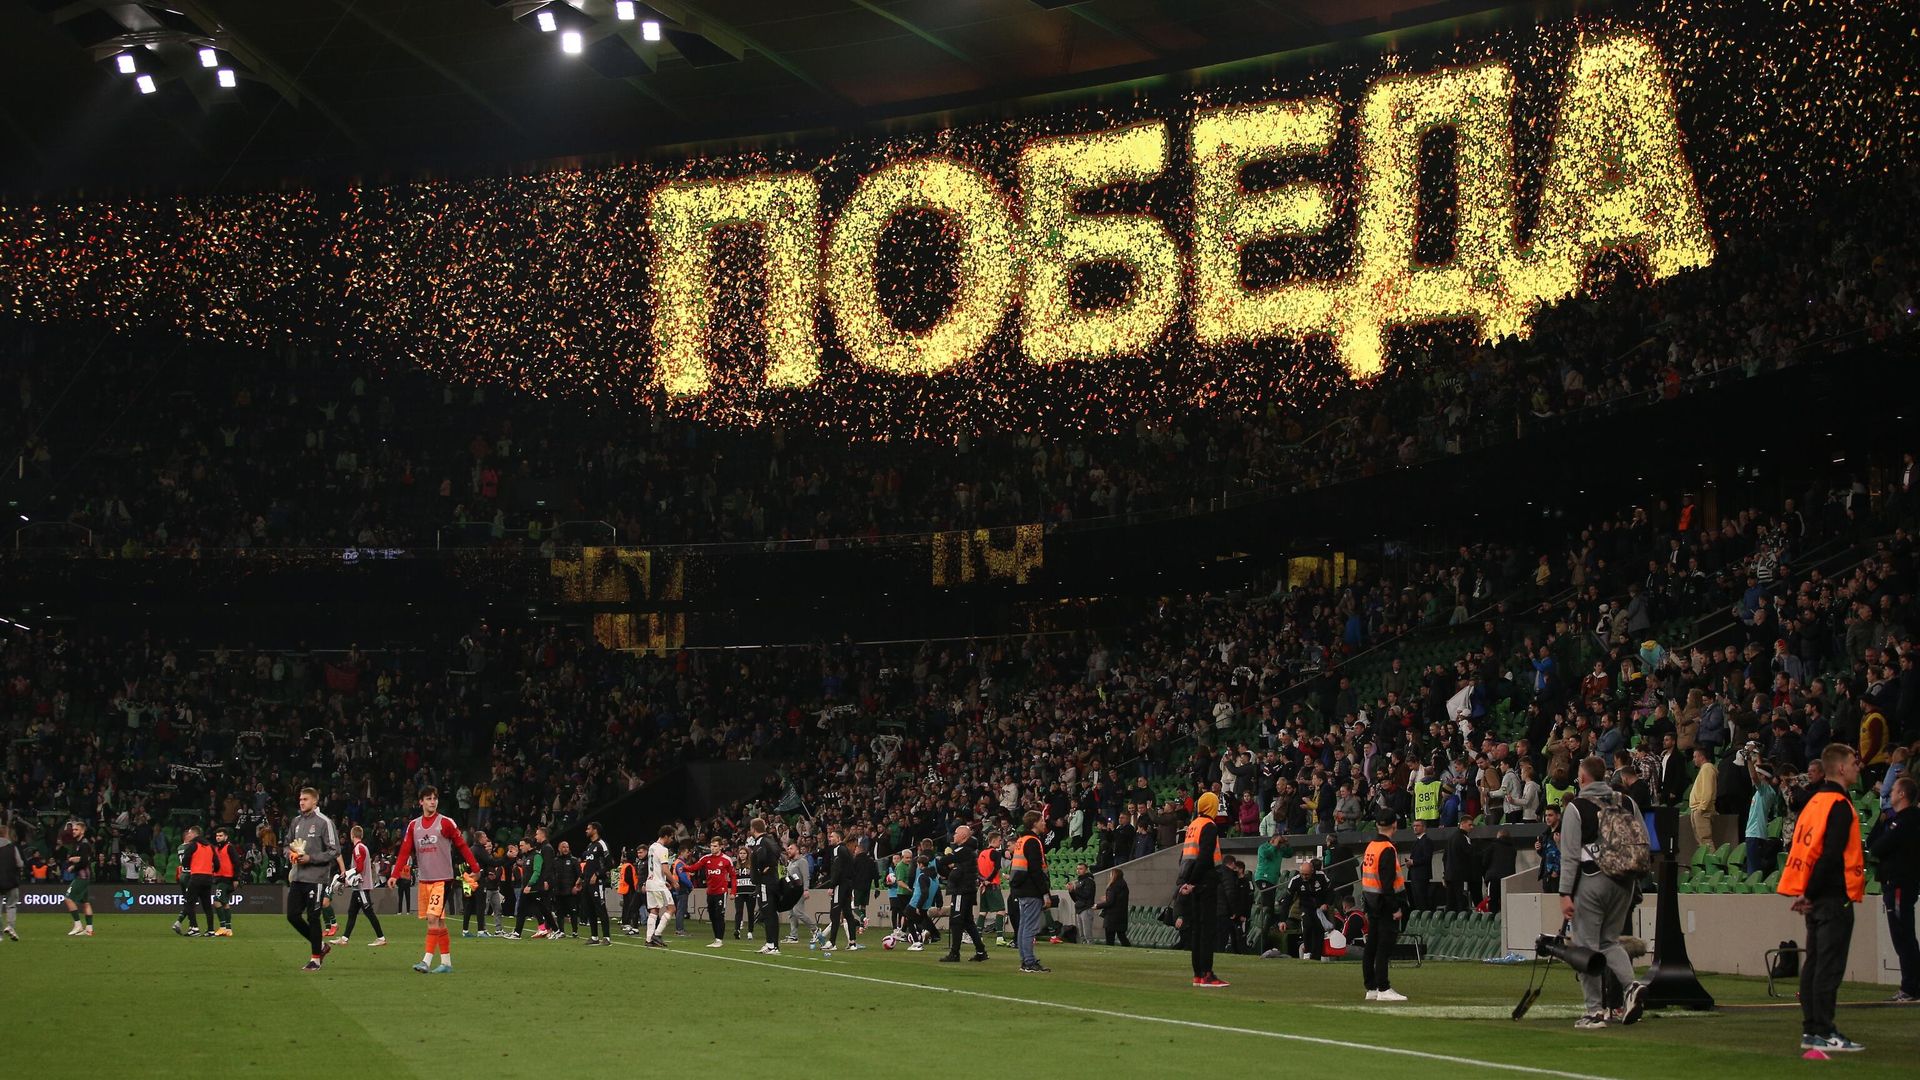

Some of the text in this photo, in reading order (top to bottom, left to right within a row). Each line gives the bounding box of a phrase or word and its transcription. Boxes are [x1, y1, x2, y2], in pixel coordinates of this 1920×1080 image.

[650, 33, 1713, 397] ПОБЕДА
[1797, 825, 1813, 847] 16
[24, 894, 65, 905] GROUP
